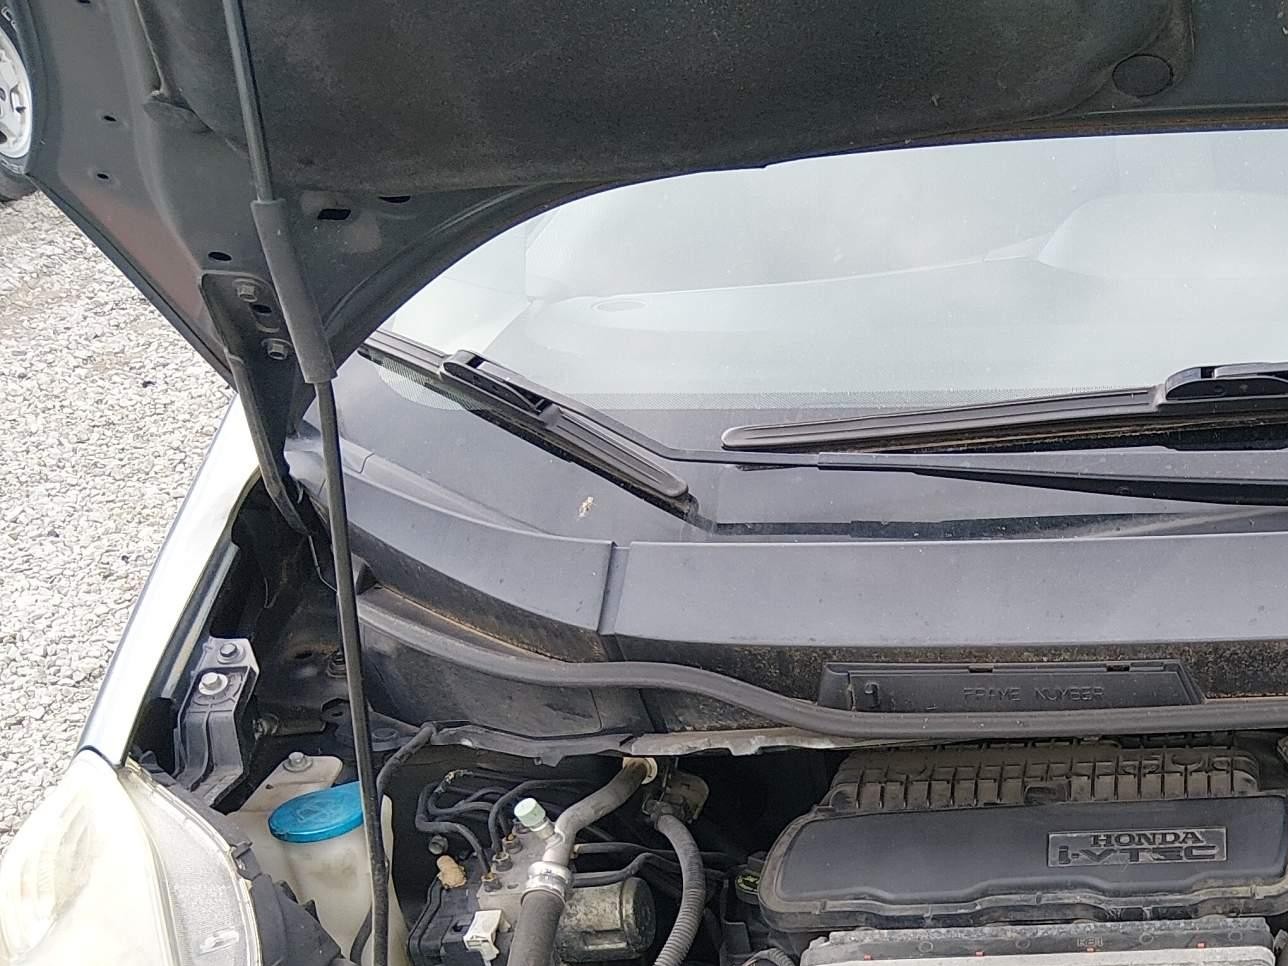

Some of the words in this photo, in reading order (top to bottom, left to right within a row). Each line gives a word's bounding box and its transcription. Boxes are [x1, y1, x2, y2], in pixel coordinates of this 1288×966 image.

[963, 687, 1021, 701] FRAME
[1034, 686, 1105, 701] NUMBER
[1090, 830, 1204, 848] HONDA
